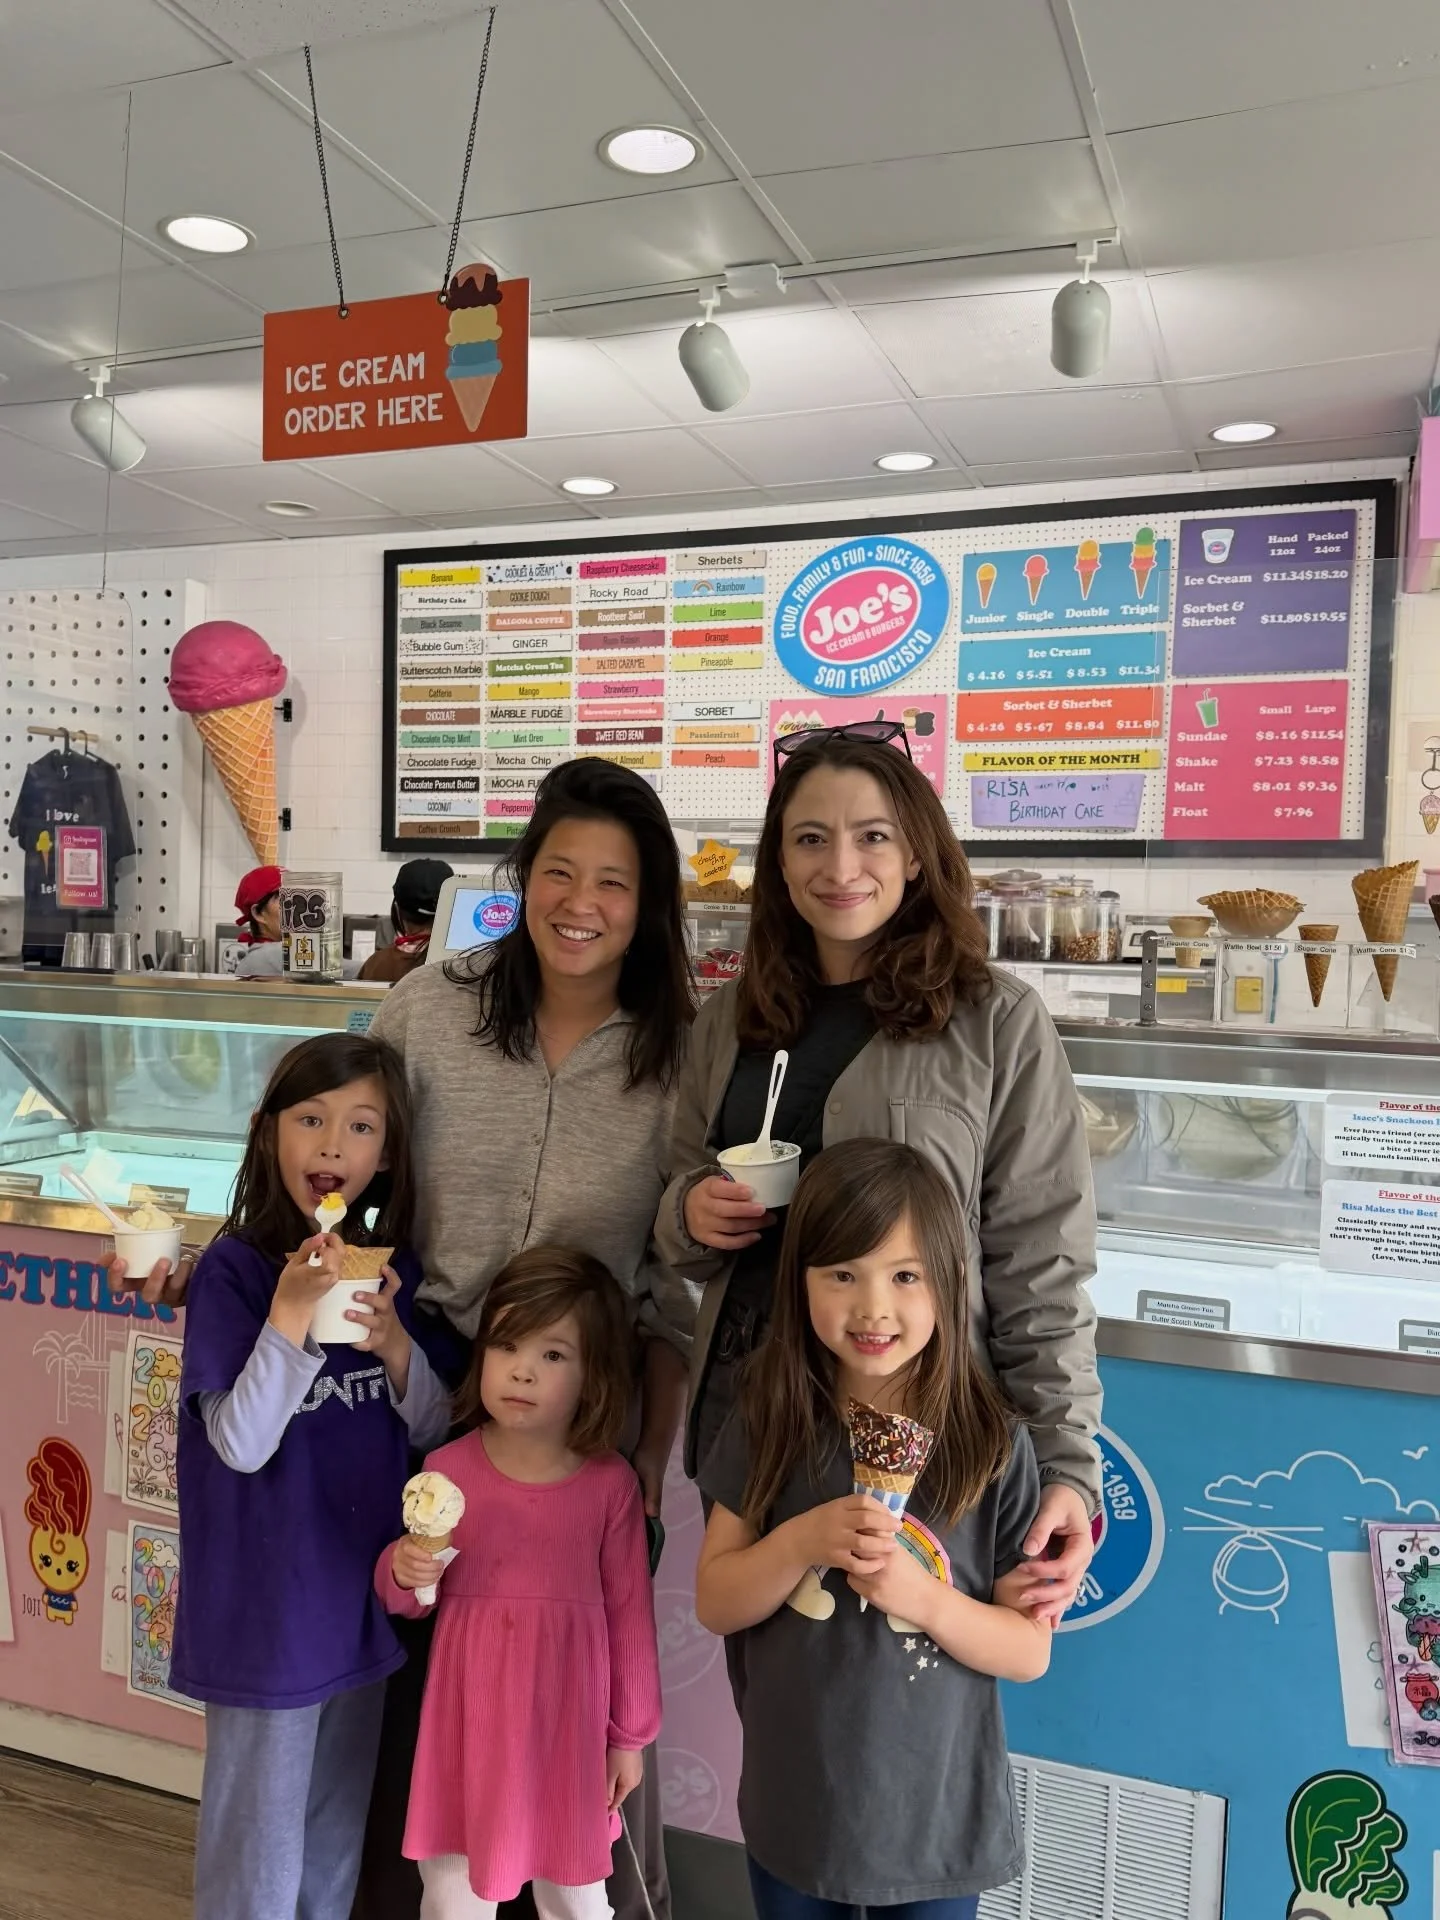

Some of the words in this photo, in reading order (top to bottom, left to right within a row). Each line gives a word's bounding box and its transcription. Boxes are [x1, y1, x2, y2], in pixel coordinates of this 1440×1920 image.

[286, 363, 327, 393] ICE
[339, 351, 425, 388] CREAM
[285, 401, 366, 435] ORDER
[378, 392, 443, 427] HERE
[1268, 534, 1298, 543] Hand
[1308, 532, 1349, 541] Packed
[698, 556, 742, 565] Sherbets
[505, 568, 527, 578] COOKIES
[535, 566, 554, 576] CREAM
[587, 564, 619, 575] Raspberry
[621, 562, 659, 572] Cheesecake
[431, 574, 453, 582] Banana
[1184, 576, 1204, 586] Ice
[1207, 574, 1252, 584] Cream
[717, 582, 745, 592] Rainbow
[780, 604, 802, 639] FOOD,
[792, 562, 831, 603] FAMILY
[842, 547, 865, 567] FUN
[875, 545, 912, 567] SINCE
[909, 556, 936, 586] 1959
[510, 592, 529, 601] COOKIE
[531, 591, 550, 600] DOUGH
[590, 589, 617, 598] Rocky
[624, 587, 648, 595] Road
[710, 608, 726, 616] Lime
[1183, 603, 1229, 613] Sorbet
[1232, 601, 1244, 611] &
[598, 613, 627, 621] Rootbeer
[629, 611, 645, 619] Swirl
[809, 582, 912, 644] Joe's
[966, 614, 1007, 624] Junior
[1017, 611, 1055, 621] Single
[1066, 607, 1110, 618] Double
[1120, 605, 1160, 615] Triple
[421, 620, 436, 629] Black
[1182, 616, 1236, 627] Sherbet
[705, 632, 729, 642] Orange
[838, 632, 867, 648] CREAM
[871, 616, 905, 638] BURGERS
[414, 643, 441, 651] Bubble
[444, 642, 463, 650] Gum
[512, 639, 548, 648] GINGER
[1028, 649, 1046, 658] Ice
[1050, 648, 1091, 657] Cream
[597, 660, 617, 669] SALTED
[619, 659, 645, 668] CARAMEL
[701, 657, 733, 667] Pineapple
[814, 666, 846, 689] SAN
[851, 629, 933, 688] FRANCISCO
[402, 666, 451, 675] Butterscotch
[454, 666, 481, 674] Marble
[519, 687, 539, 696] Mango
[604, 685, 638, 694] Strawberry
[1003, 701, 1045, 711] Sorbet
[1048, 701, 1059, 709] &
[1062, 699, 1112, 709] Sherbet
[1260, 706, 1292, 714] Small
[1305, 705, 1336, 714] Large
[426, 712, 455, 720] CHOCOLATE
[491, 710, 527, 718] MARBLE
[532, 710, 563, 718] FUDGE
[695, 707, 735, 716] SORBET
[412, 735, 440, 743] Chocolate
[442, 735, 455, 743] Chip
[458, 734, 470, 742] Mint
[529, 734, 543, 742] Oreo
[596, 732, 615, 741] SWEET
[616, 731, 627, 740] RED
[628, 730, 644, 740] BEAN
[1177, 732, 1228, 741] Sundae
[1256, 731, 1297, 740] $8.16
[531, 756, 551, 765] Chip
[620, 756, 644, 765] Almond
[705, 754, 725, 762] Peach
[983, 756, 1034, 766] FLAVOR
[1039, 756, 1055, 765] OF
[1060, 756, 1086, 764] THE
[1090, 754, 1140, 764] MONTH
[1176, 757, 1218, 766] Shake
[452, 759, 476, 768] Fudge
[404, 780, 433, 789] Chocolate
[435, 781, 455, 789] Peanut
[458, 781, 476, 789] Butter
[1174, 782, 1205, 792] Malt
[987, 781, 1029, 799] RISA
[428, 803, 451, 811] COCONUT
[1173, 807, 1208, 817] Float
[418, 825, 437, 833] Coffee
[440, 825, 460, 833] Crunch
[1380, 1101, 1410, 1110] Flavor
[1379, 1190, 1410, 1198] Flavor
[1342, 1203, 1363, 1211] Risa
[1365, 1205, 1395, 1214] Makes
[1338, 1217, 1378, 1226] Classically
[1380, 1221, 1408, 1229] creamy
[1353, 1235, 1384, 1243] through
[1104, 1474, 1138, 1520] 1959
